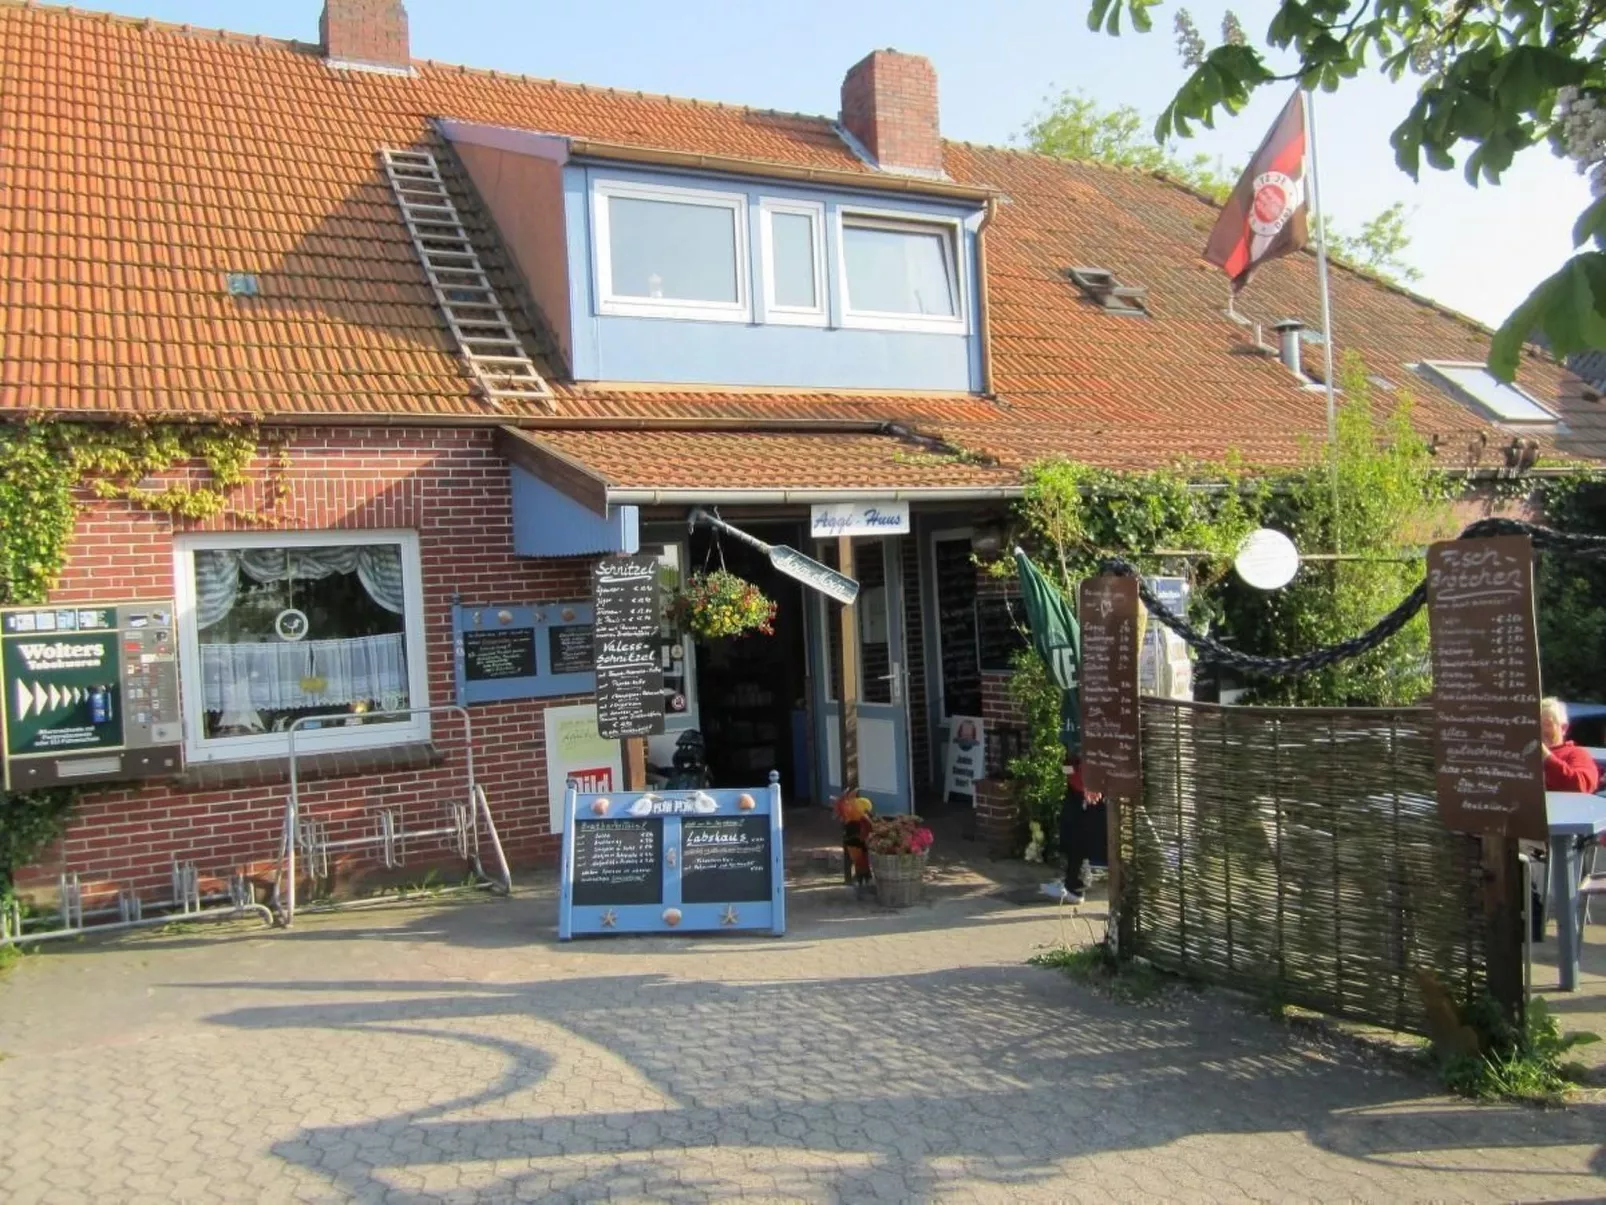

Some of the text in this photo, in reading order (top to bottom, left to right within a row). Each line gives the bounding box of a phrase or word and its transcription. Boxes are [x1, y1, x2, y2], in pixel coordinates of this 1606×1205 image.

[813, 512, 853, 534] Aggi
[863, 509, 902, 526] Huus
[595, 560, 656, 576] Schnitzel
[17, 642, 105, 659] Wolters
[596, 650, 656, 664] Schnitzel
[686, 830, 748, 844] Labskaus
